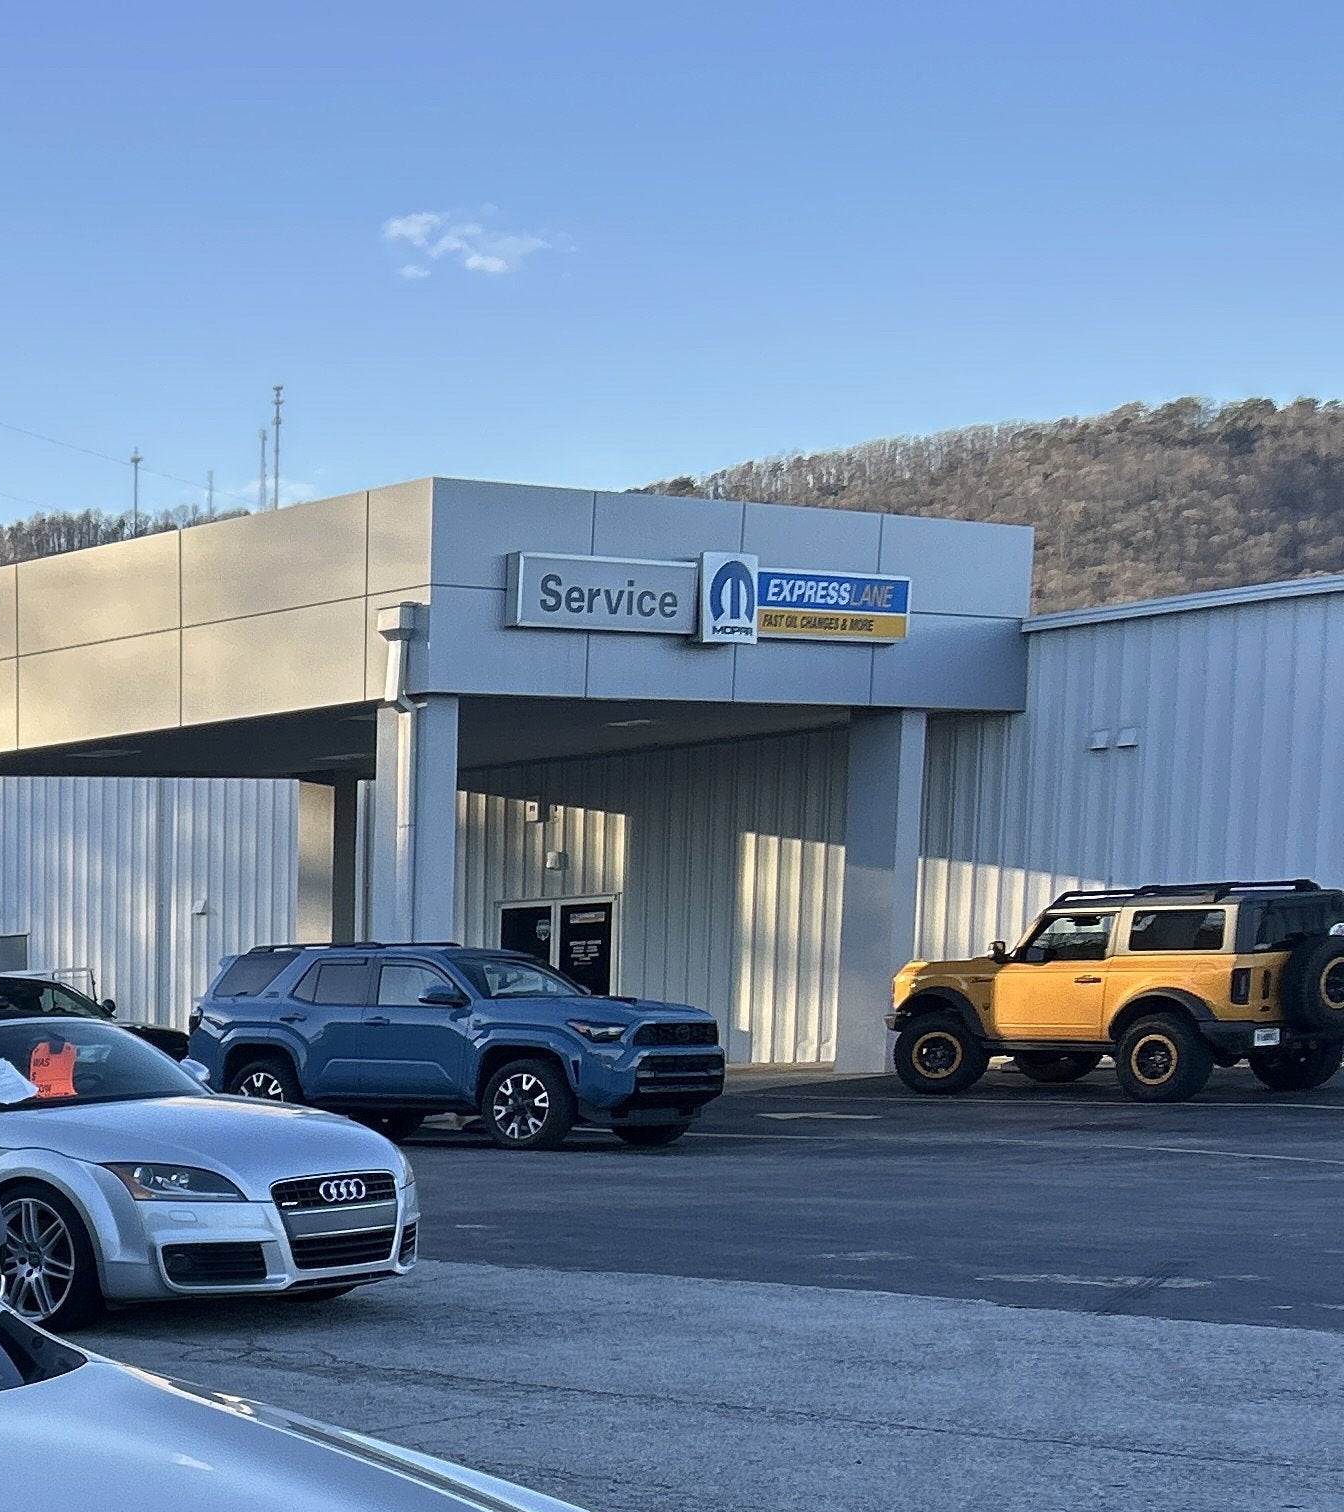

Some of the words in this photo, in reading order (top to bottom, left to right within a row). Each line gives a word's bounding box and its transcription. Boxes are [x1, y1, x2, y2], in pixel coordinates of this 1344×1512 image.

[539, 573, 678, 619] Service
[761, 613, 784, 628] FAST
[785, 614, 798, 629] OIL
[800, 616, 839, 631] CHANGES
[840, 618, 848, 631] &
[849, 618, 875, 632] MORE
[712, 625, 754, 637] MOPAR
[32, 1058, 50, 1068] WAS
